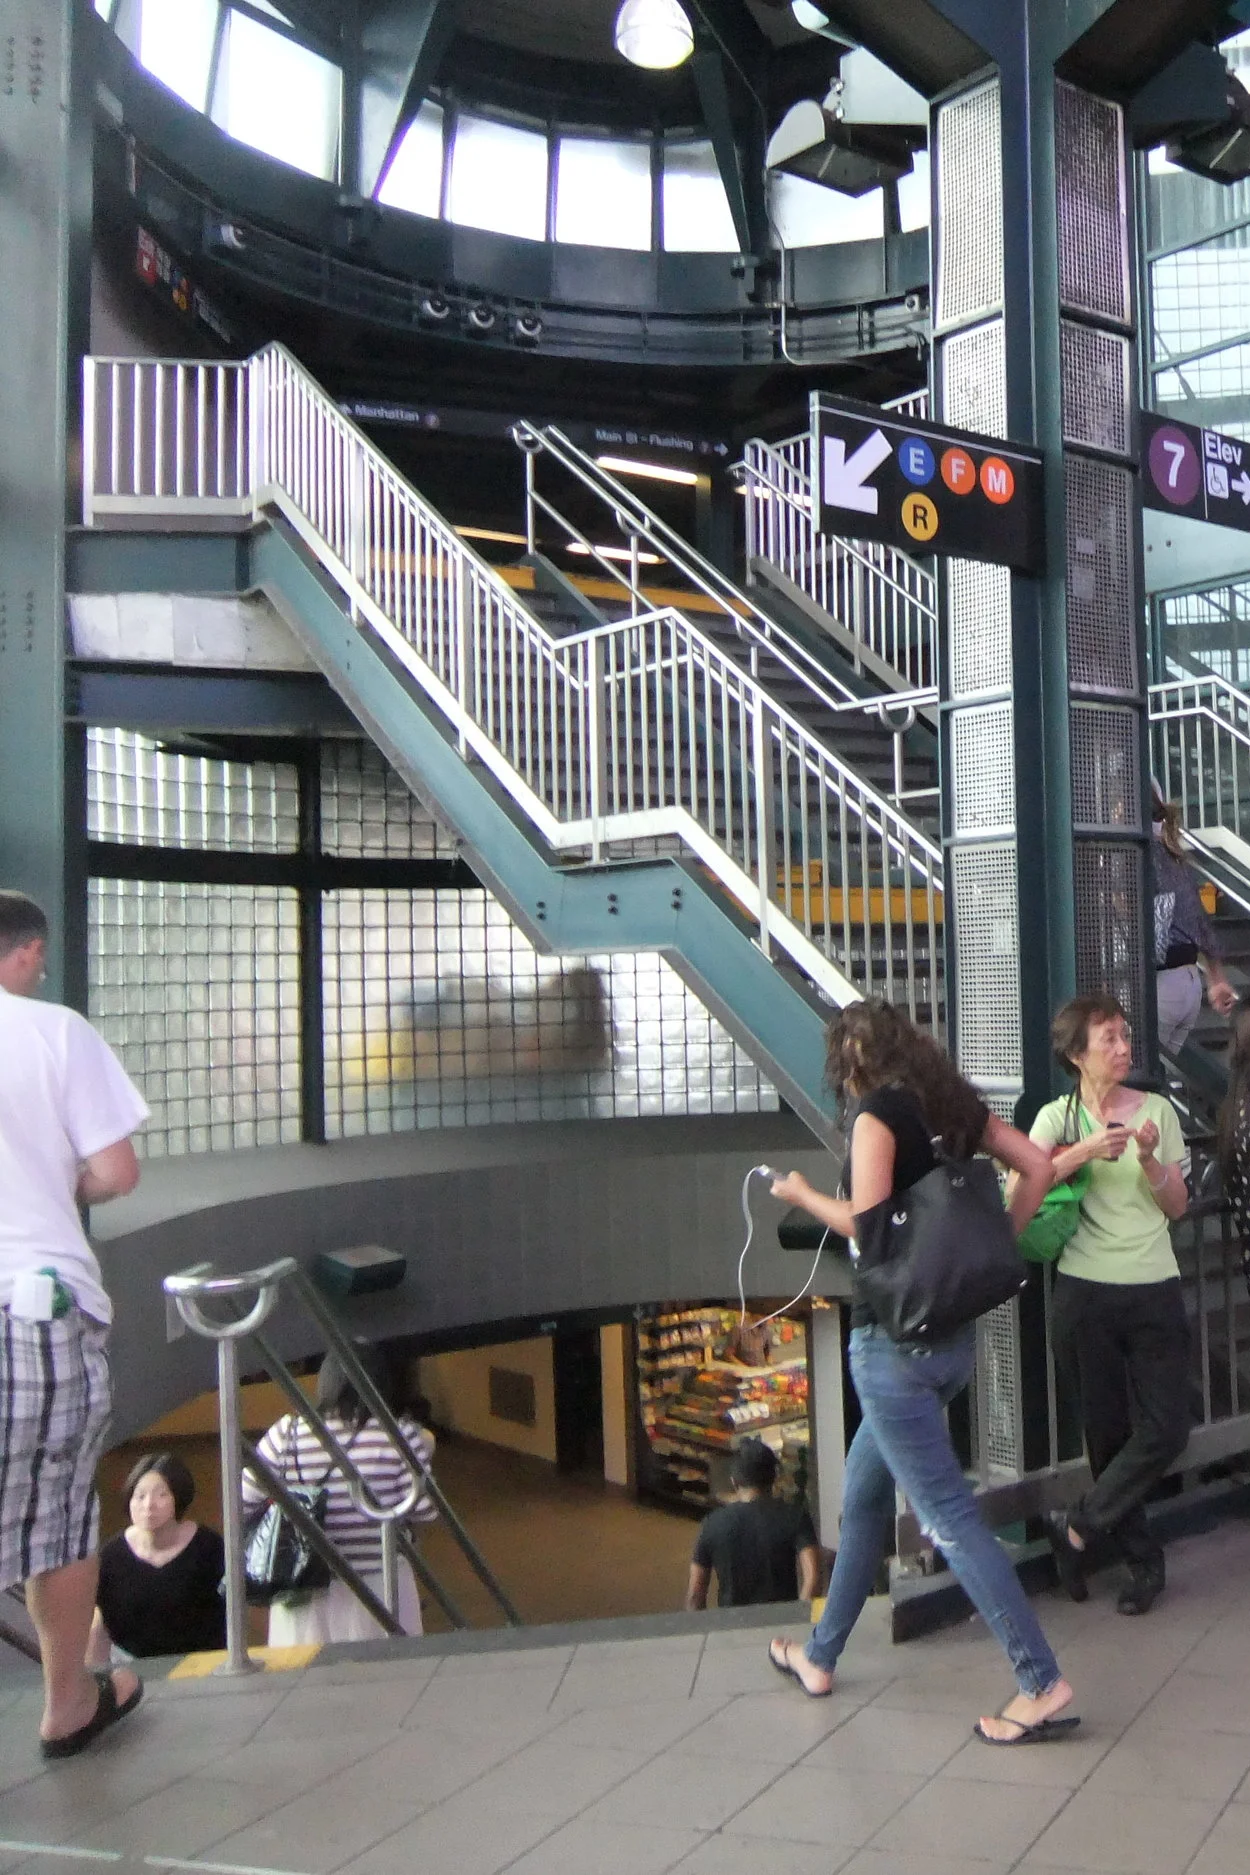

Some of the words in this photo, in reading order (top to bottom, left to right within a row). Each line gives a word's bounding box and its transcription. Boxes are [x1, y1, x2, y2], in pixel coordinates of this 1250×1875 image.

[1163, 440, 1185, 488] 7
[1204, 431, 1242, 466] Elev
[909, 447, 925, 476] E
[951, 457, 966, 484] F
[988, 466, 1007, 495] M
[912, 504, 928, 531] R
